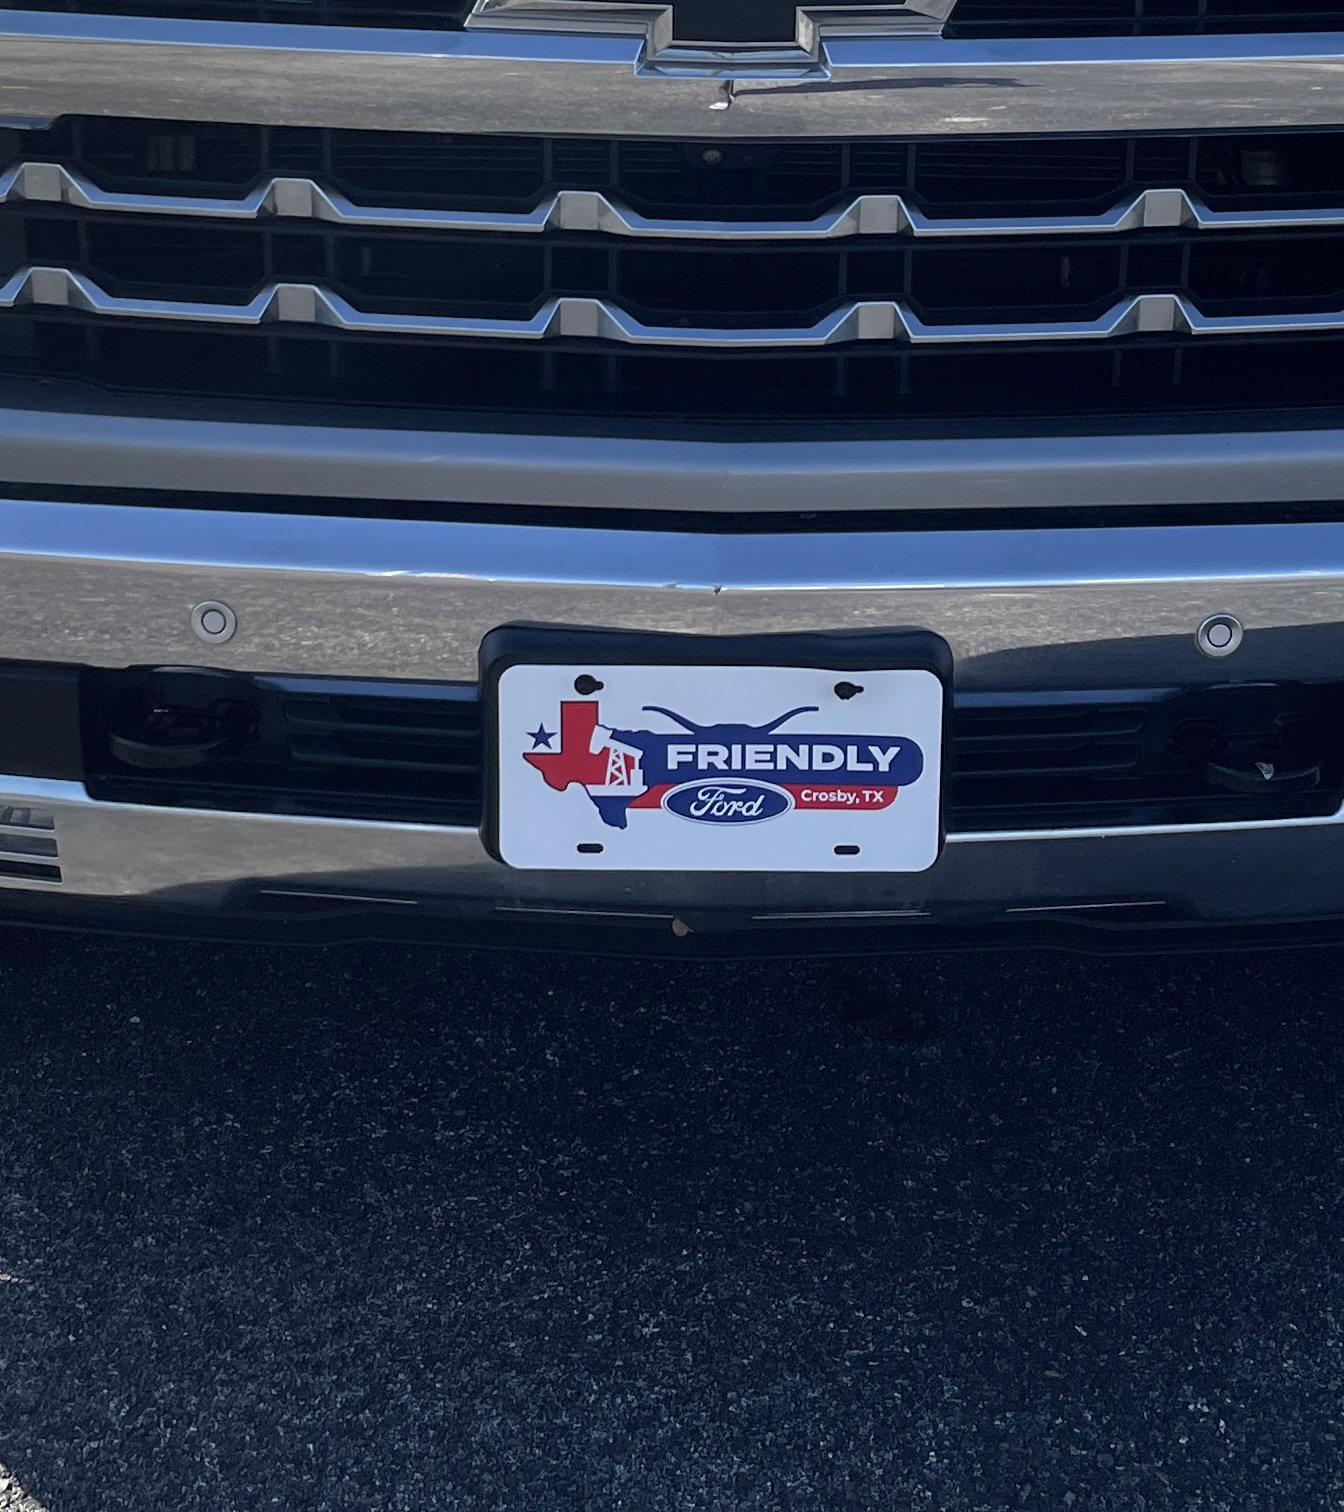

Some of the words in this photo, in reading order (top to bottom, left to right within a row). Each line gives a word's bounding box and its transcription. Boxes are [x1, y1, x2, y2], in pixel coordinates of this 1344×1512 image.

[667, 743, 901, 772] FRIENDLY
[689, 787, 765, 819] Ford
[800, 789, 861, 805] Crosby,
[862, 790, 885, 804] TX
